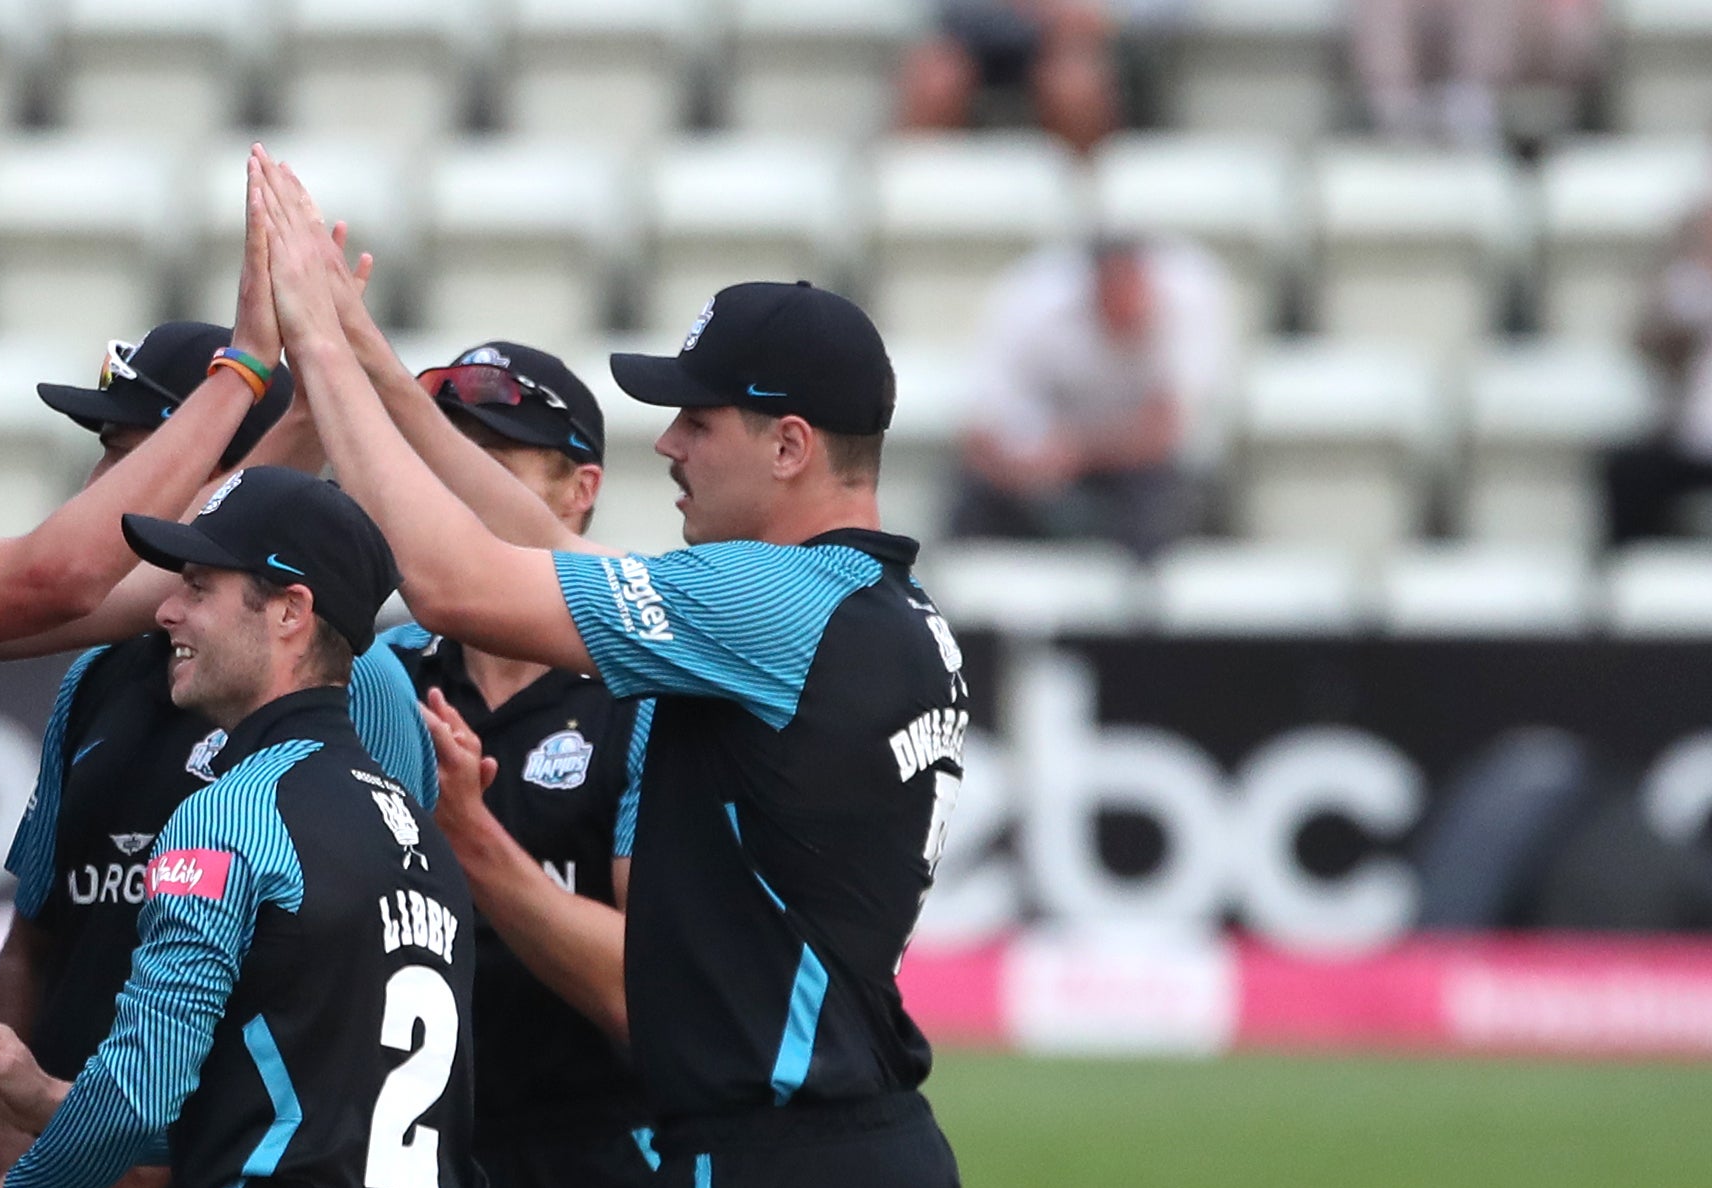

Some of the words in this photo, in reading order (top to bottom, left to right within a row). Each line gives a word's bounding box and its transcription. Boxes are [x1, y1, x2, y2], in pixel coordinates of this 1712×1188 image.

[619, 557, 674, 640] angley
[151, 855, 205, 893] Vtality
[379, 889, 459, 965] LIBBY
